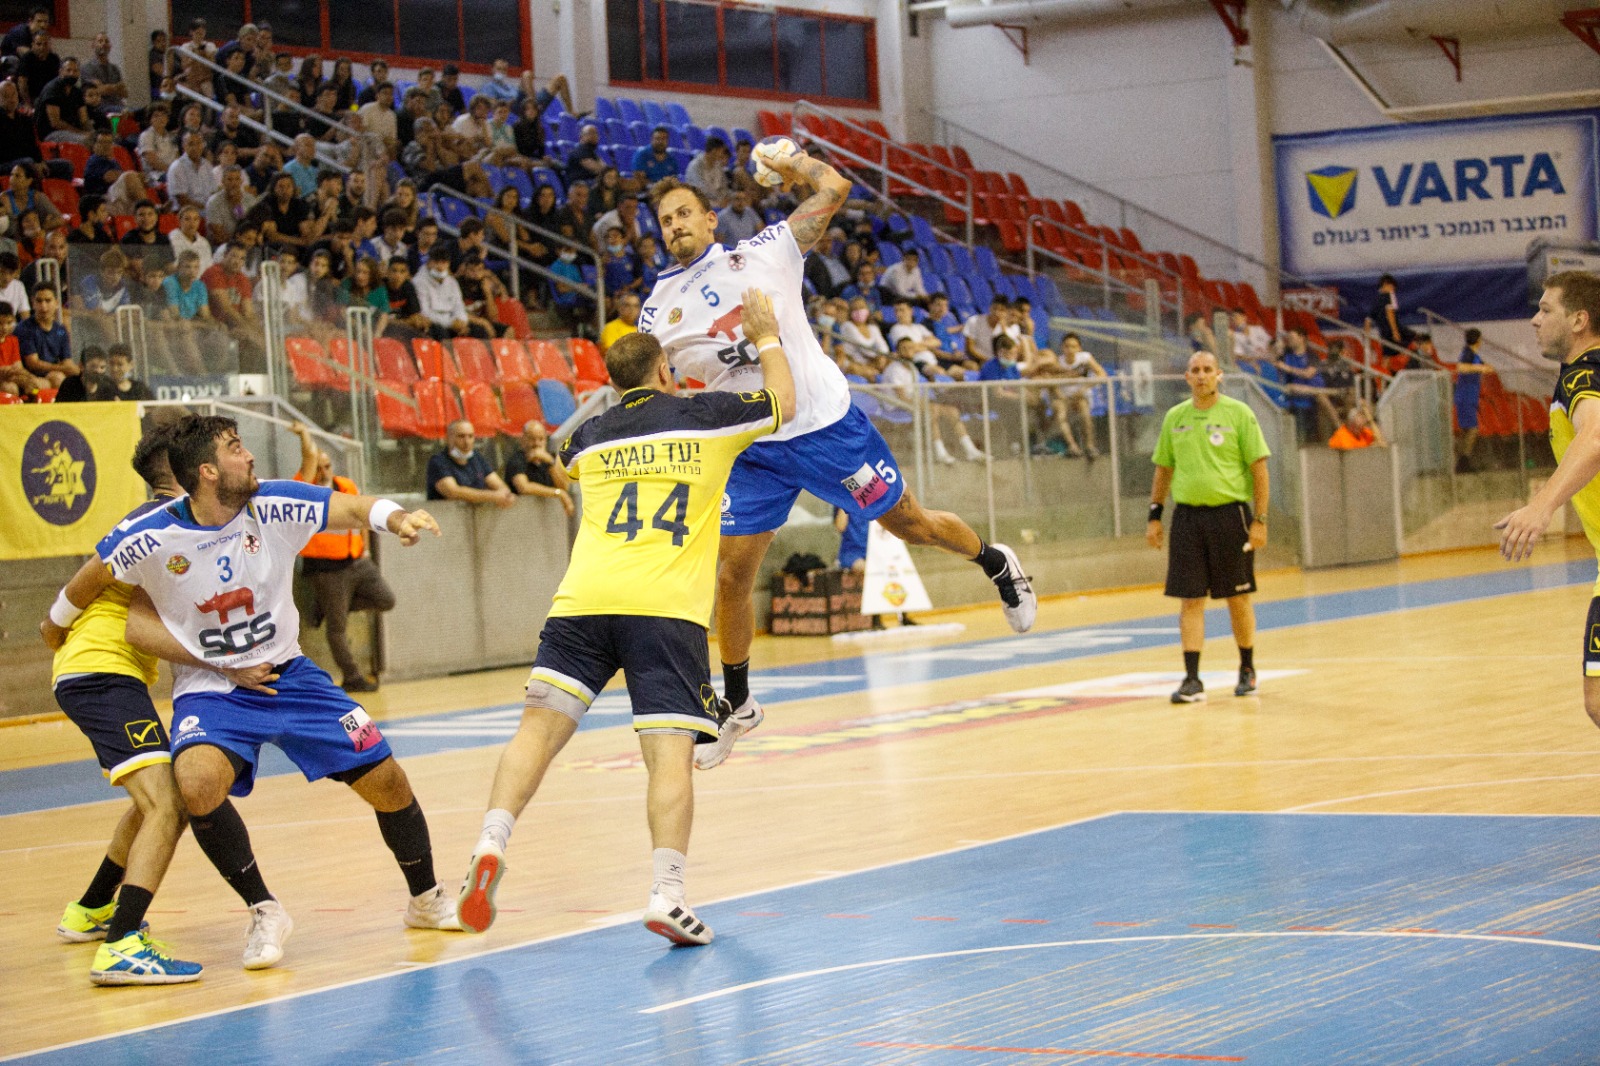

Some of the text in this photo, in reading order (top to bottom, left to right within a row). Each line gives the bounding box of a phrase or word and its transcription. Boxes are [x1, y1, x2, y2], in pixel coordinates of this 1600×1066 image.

[1371, 153, 1566, 207] VARTA
[738, 224, 786, 251] ARTA
[1313, 214, 1566, 246] המצבר הנמכר ביותר בעולם
[680, 260, 715, 294] GIVOVA
[700, 284, 720, 307] 5
[640, 306, 658, 335] RTA
[604, 468, 628, 479] הבית
[875, 459, 896, 484] 5
[257, 503, 317, 524] VARTA
[606, 481, 690, 548] 44
[197, 531, 242, 551] GIVOVA
[217, 555, 233, 583] 3
[199, 611, 276, 658] SGS
[344, 718, 360, 733] OR
